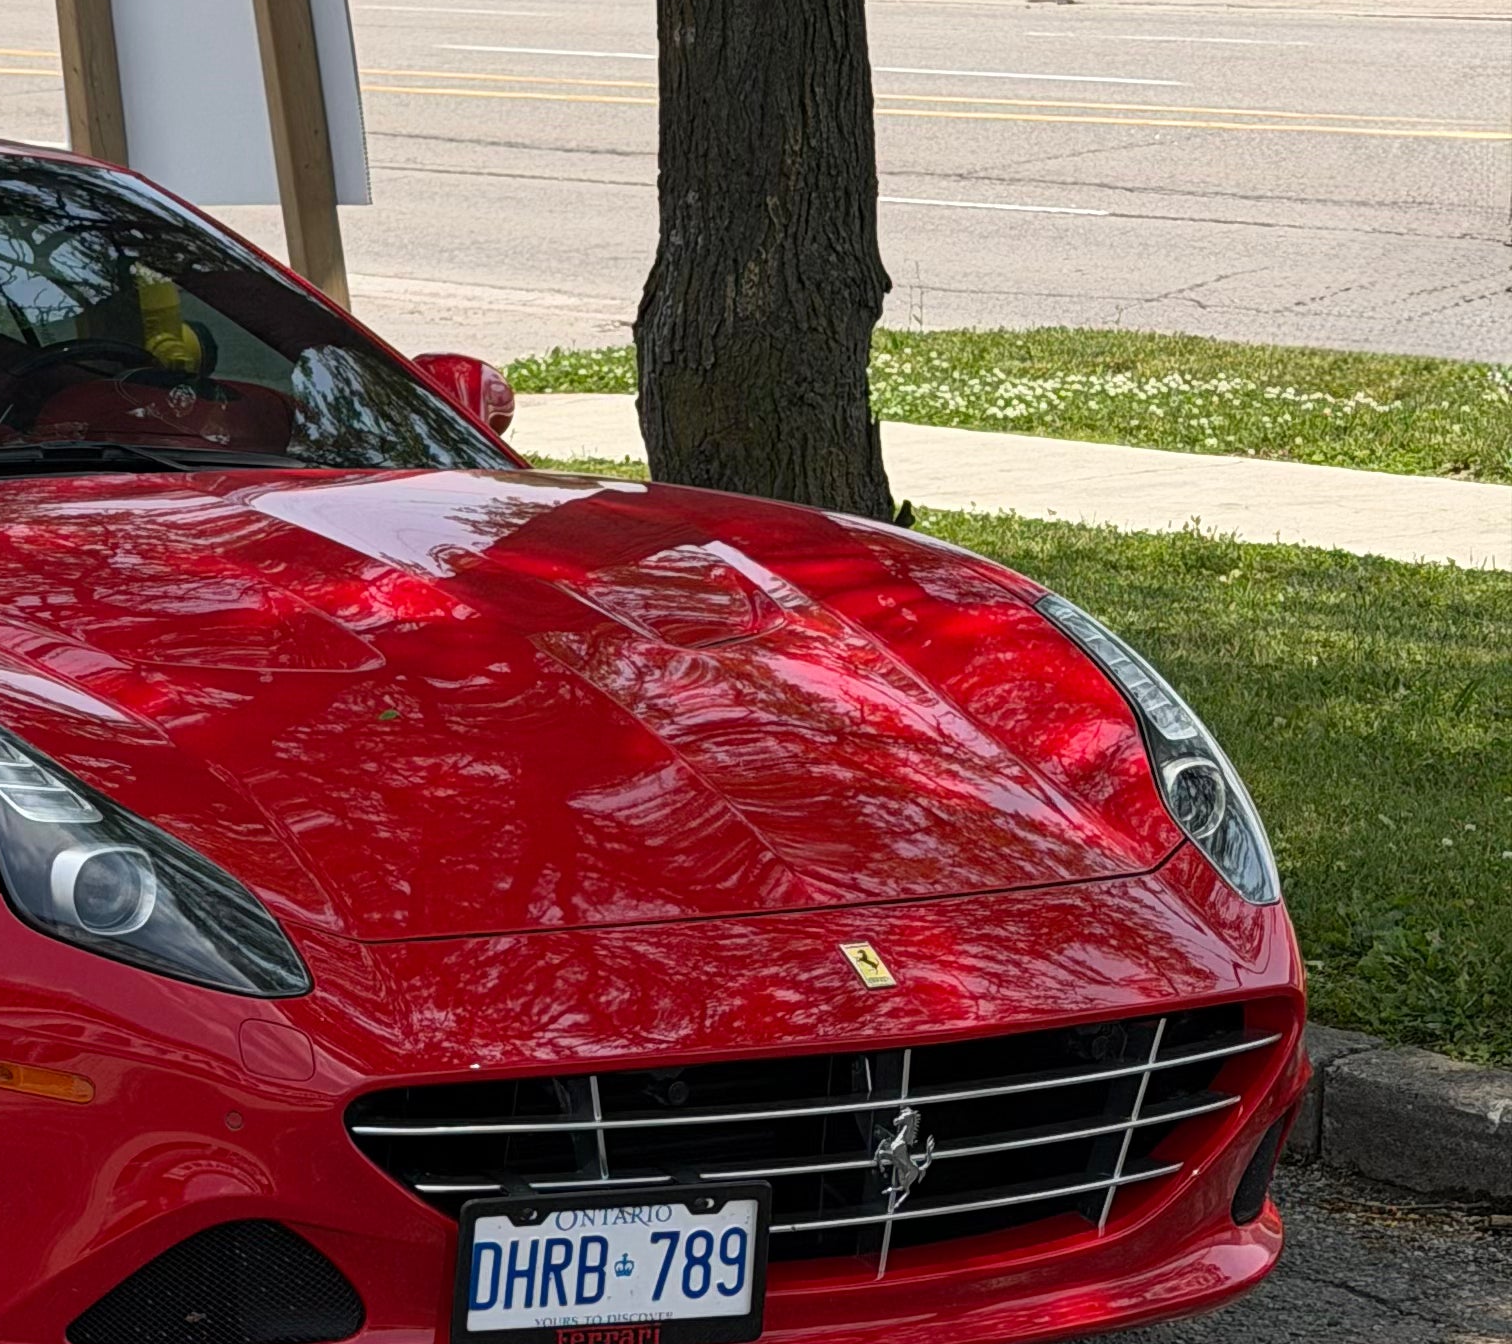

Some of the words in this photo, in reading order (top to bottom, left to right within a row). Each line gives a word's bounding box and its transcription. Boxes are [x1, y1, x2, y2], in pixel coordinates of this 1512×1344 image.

[555, 1206, 673, 1232] ONTARIO
[468, 1235, 610, 1312] DHRB
[650, 1226, 748, 1302] 789
